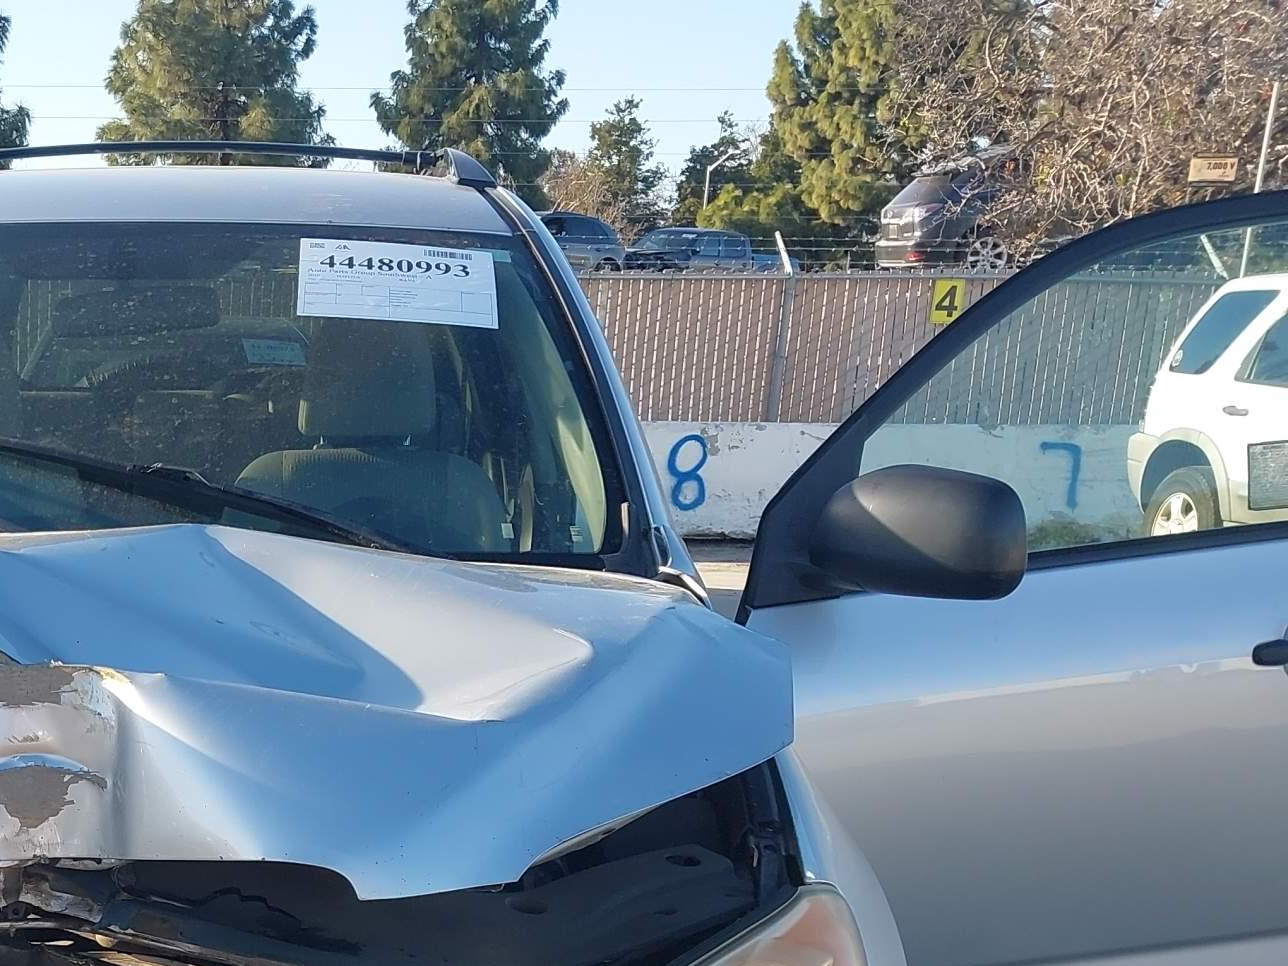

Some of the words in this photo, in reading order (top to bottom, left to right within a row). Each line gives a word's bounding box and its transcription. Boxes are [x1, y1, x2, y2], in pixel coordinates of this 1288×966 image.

[319, 254, 470, 278] 44480993
[935, 285, 958, 317] 4
[667, 433, 709, 512] 8
[1039, 441, 1082, 513] 7
